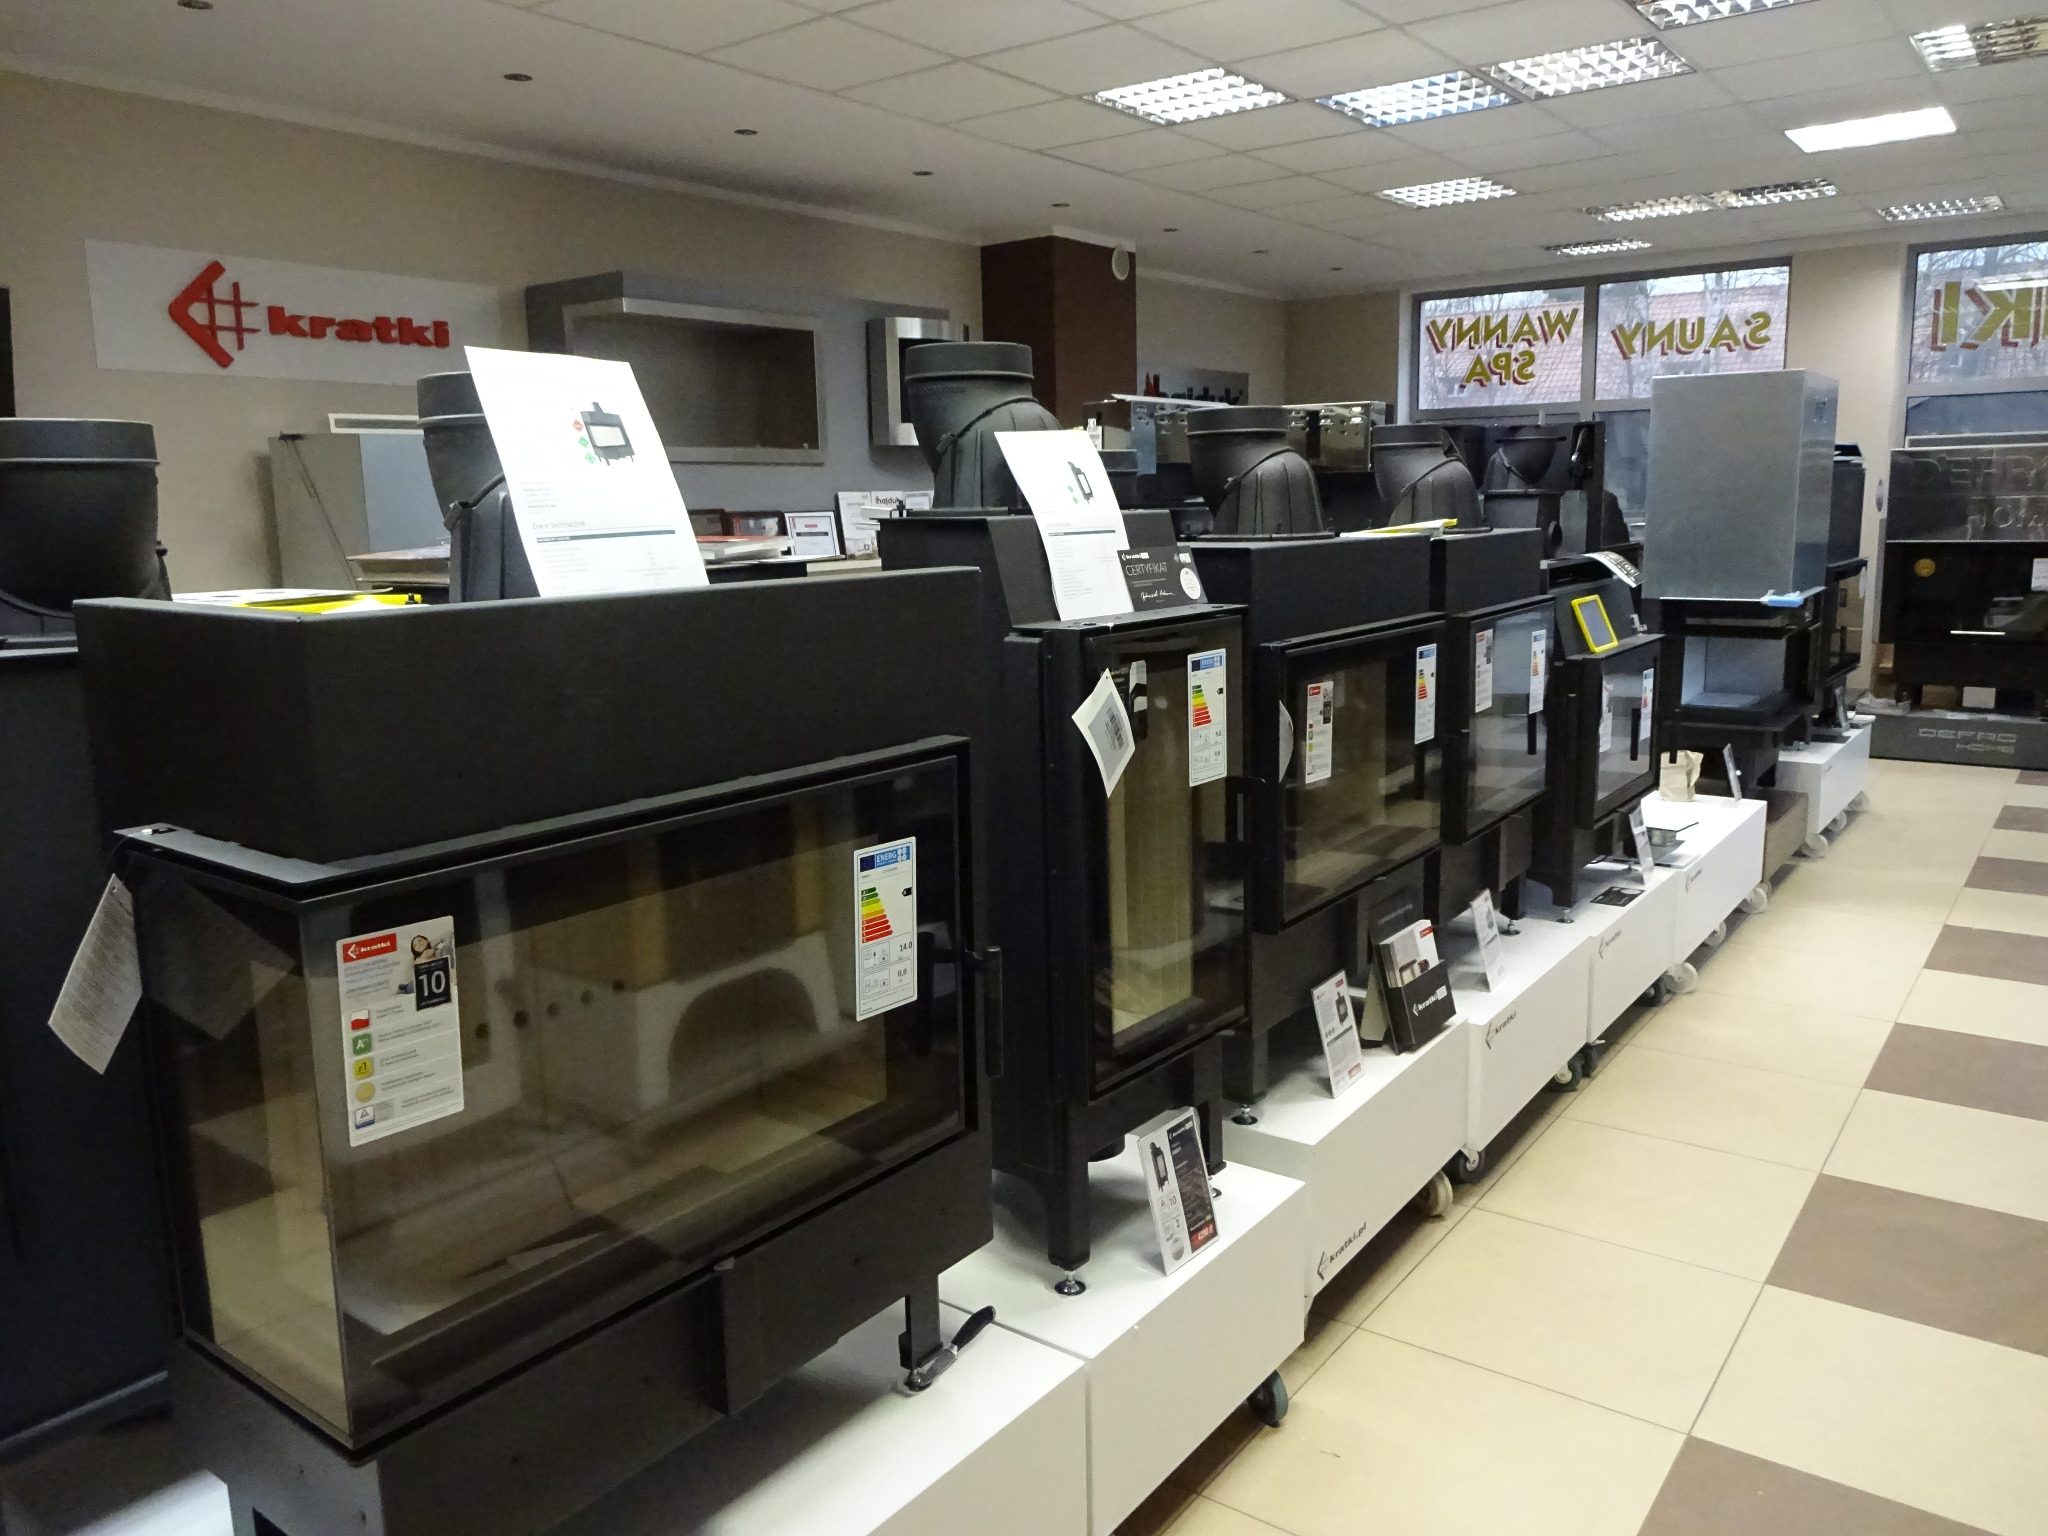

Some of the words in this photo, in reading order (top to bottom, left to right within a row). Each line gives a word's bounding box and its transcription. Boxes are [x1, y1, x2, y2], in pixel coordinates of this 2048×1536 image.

[267, 305, 450, 348] kratki
[1126, 562, 1168, 576] CERTYFIKAT
[876, 851, 897, 863] ENERG
[361, 941, 391, 953] kratki
[418, 970, 446, 997] 10
